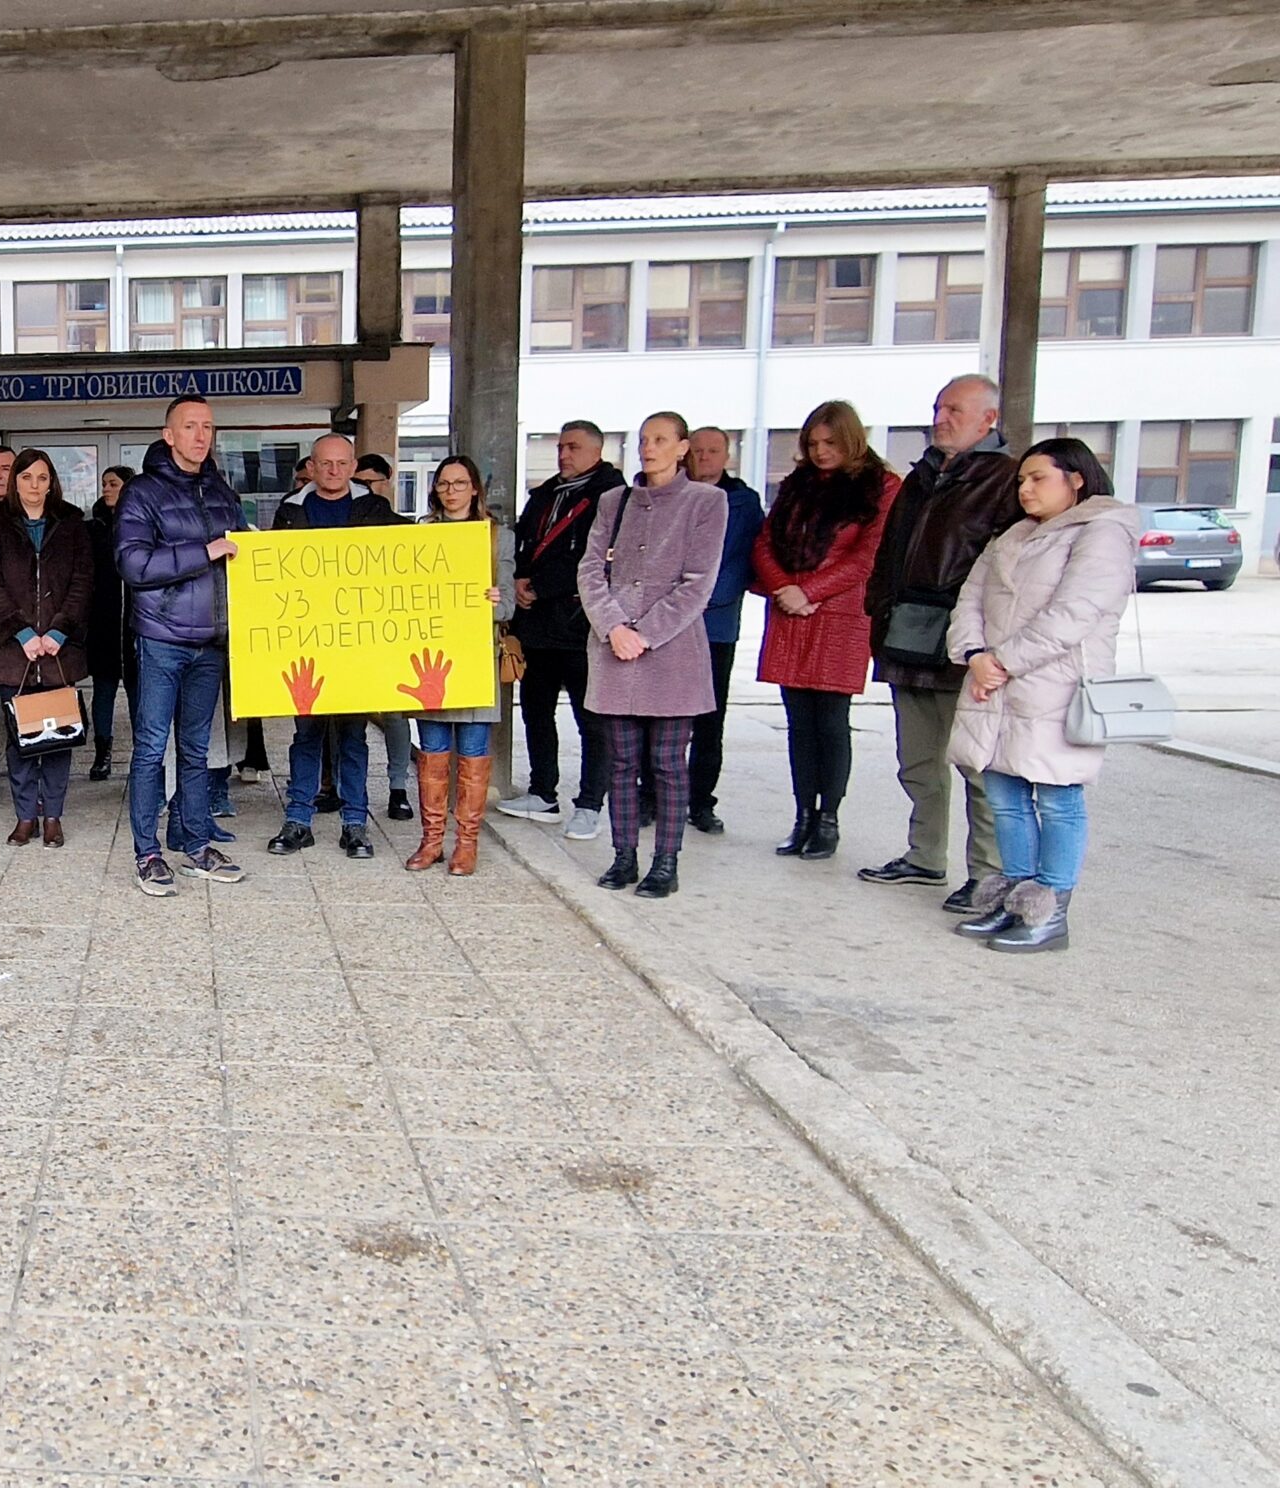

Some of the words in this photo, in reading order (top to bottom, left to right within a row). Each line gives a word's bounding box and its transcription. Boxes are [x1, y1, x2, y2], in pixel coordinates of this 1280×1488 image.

[42, 372, 200, 399] ТРГОВИНСКА
[205, 369, 298, 394] ШКОЛА
[251, 543, 451, 582] ЕКОНОМСКА
[275, 589, 310, 620] УЗ
[335, 582, 481, 616] СТУДЕНТЕ
[249, 616, 445, 653] ПРИЈЕПОЉЕ
